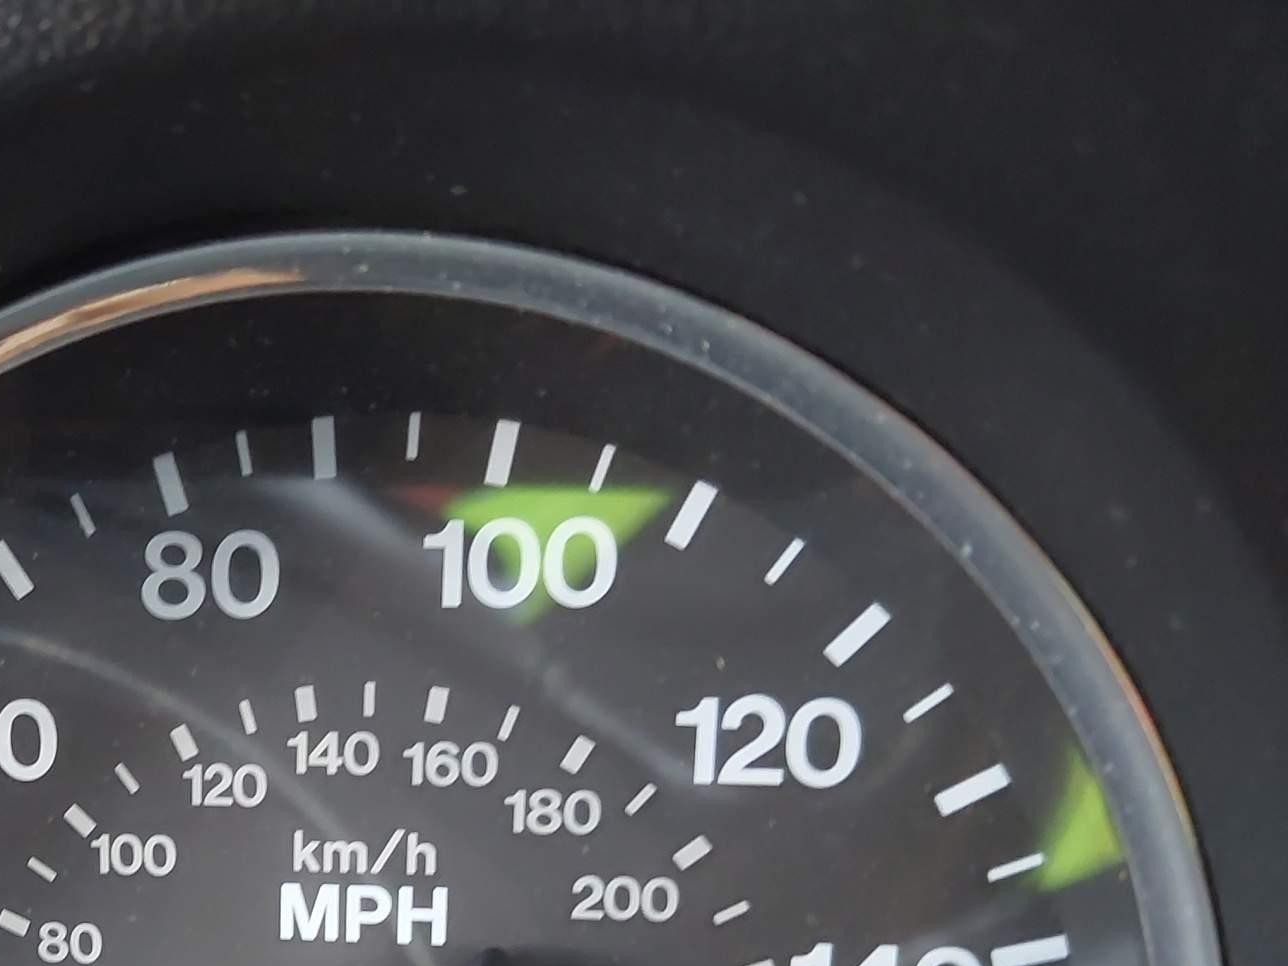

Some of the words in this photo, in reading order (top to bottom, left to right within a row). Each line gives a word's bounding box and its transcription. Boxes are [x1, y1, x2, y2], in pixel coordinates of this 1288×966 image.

[140, 529, 281, 621] 80
[423, 516, 618, 609] 100
[286, 730, 381, 777] 140
[402, 740, 499, 788] 160
[675, 693, 863, 790] 120
[182, 761, 268, 808] 120
[503, 788, 602, 836] 180
[90, 832, 177, 877] 100
[292, 827, 438, 876] km/h
[278, 881, 450, 947] MPH
[570, 874, 680, 923] 200
[37, 921, 103, 965] 80
